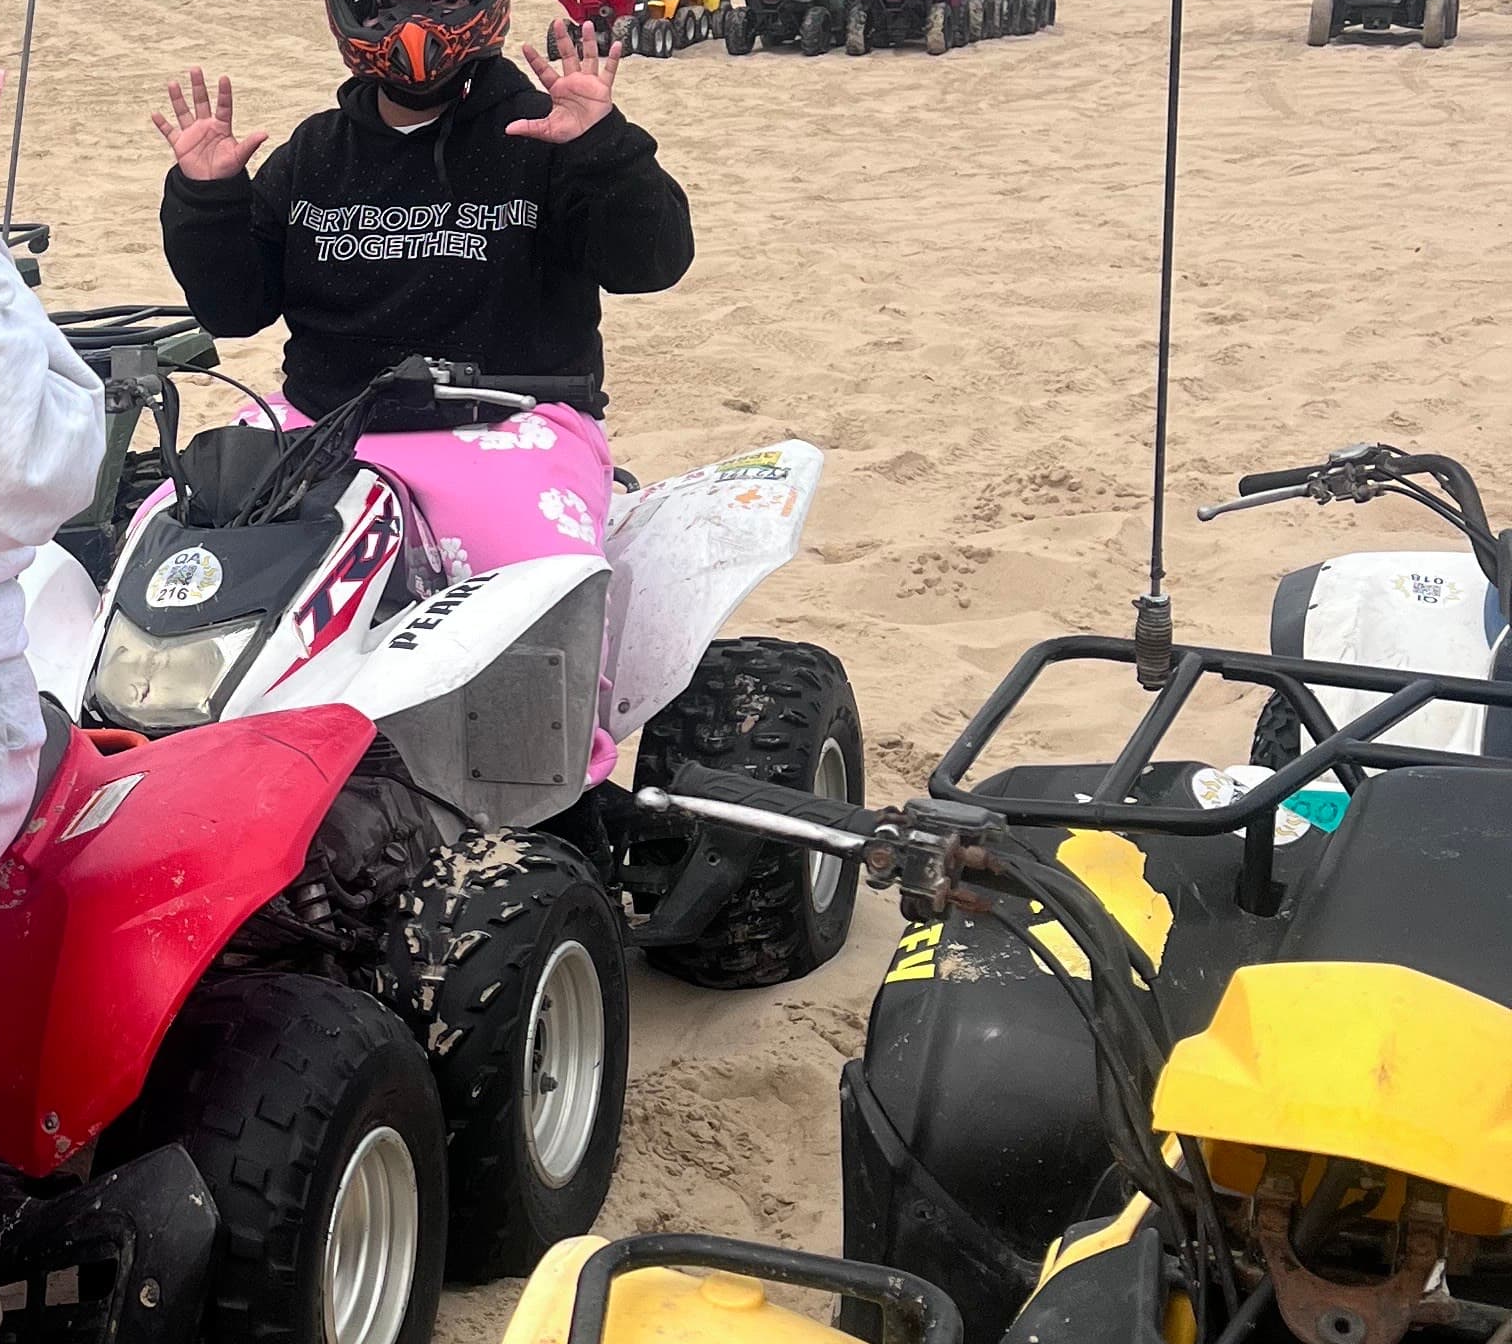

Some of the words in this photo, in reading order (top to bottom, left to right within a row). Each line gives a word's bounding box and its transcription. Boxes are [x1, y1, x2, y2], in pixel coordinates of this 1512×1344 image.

[315, 230, 487, 262] TOGETHER
[174, 552, 201, 565] QA
[157, 586, 189, 602] 216
[388, 572, 500, 651] PEARL
